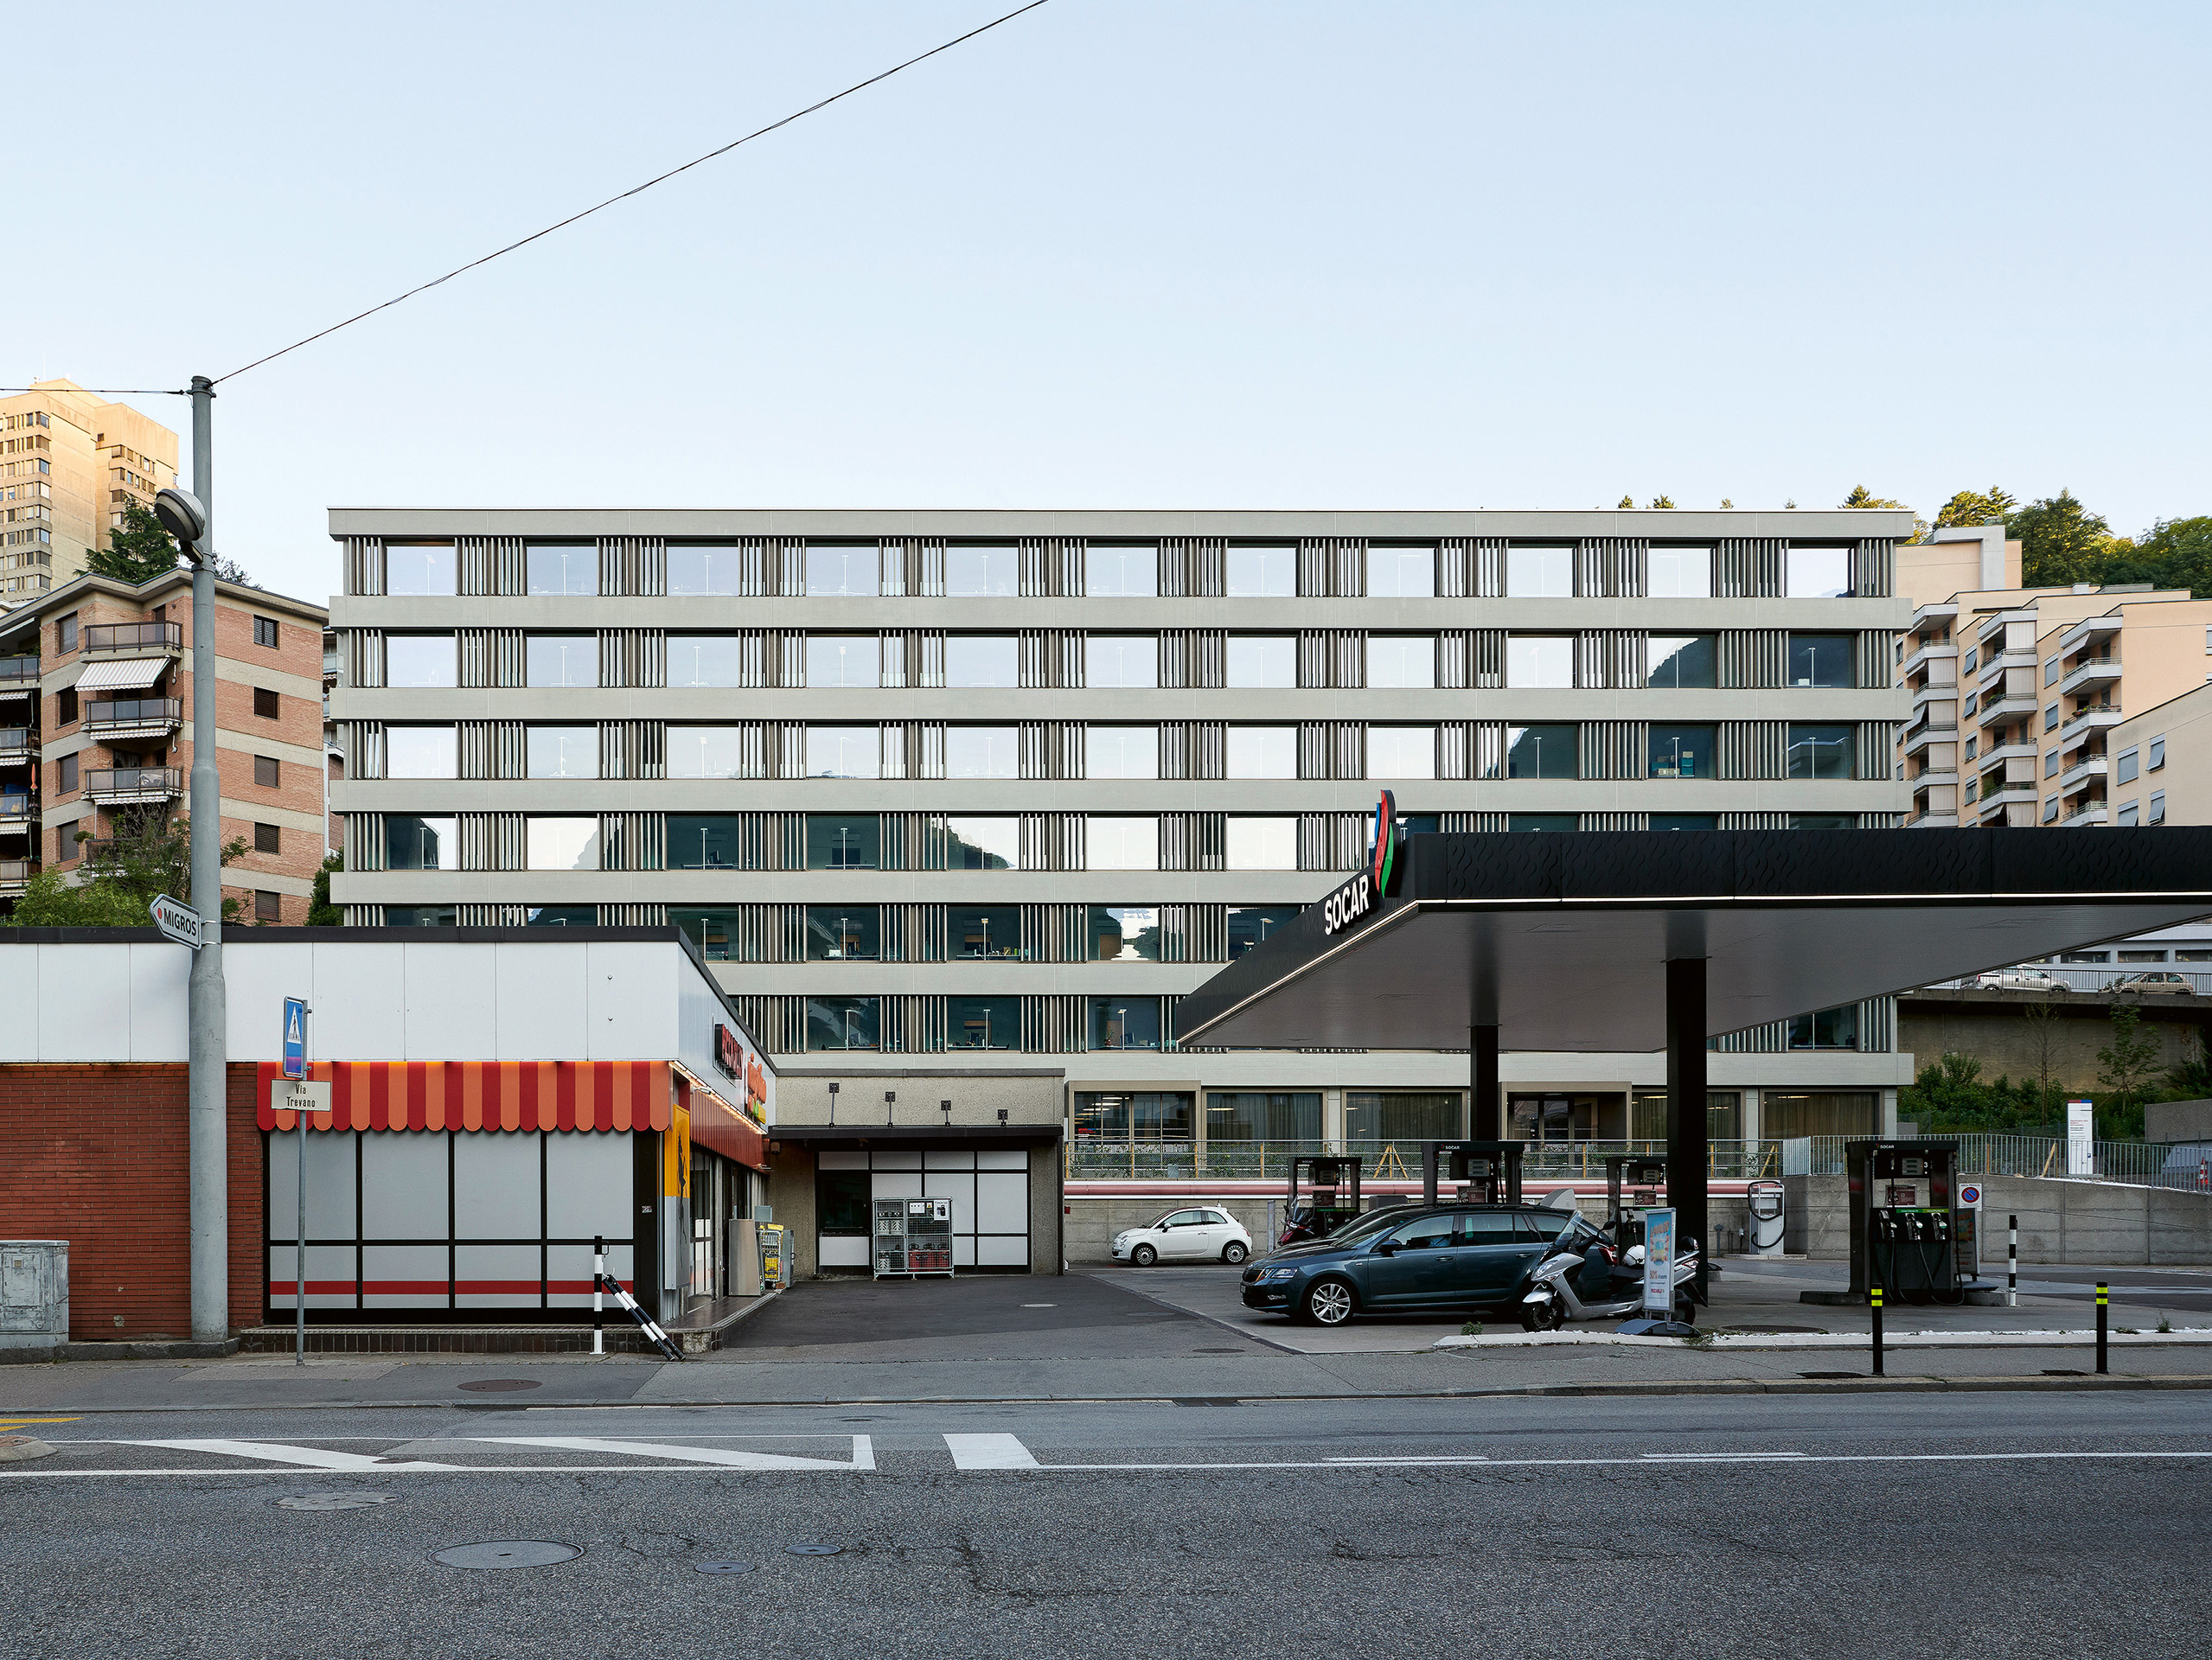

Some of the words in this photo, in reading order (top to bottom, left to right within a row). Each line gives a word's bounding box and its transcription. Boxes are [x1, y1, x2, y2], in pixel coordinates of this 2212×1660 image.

[1324, 874, 1370, 935] SOCAR
[163, 908, 197, 936] MIGROS
[296, 1084, 307, 1094] Via
[286, 1096, 316, 1108] Trevano
